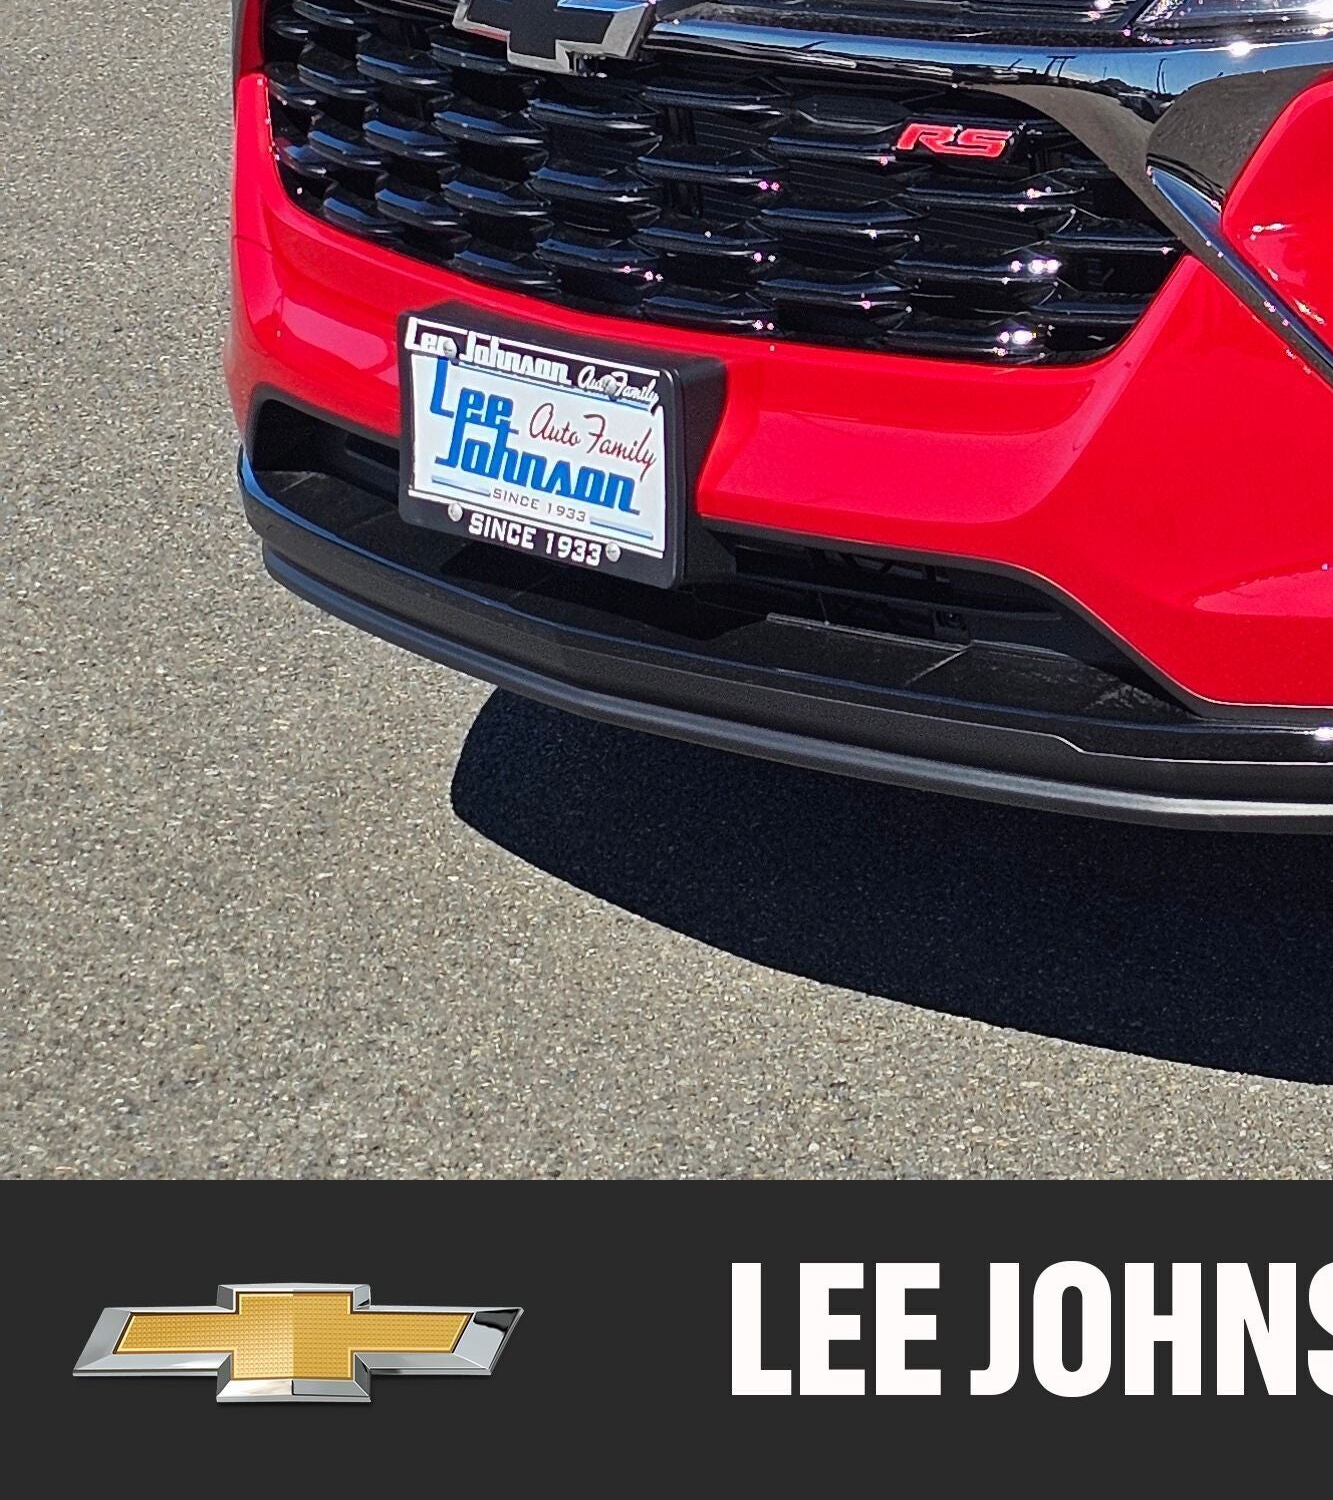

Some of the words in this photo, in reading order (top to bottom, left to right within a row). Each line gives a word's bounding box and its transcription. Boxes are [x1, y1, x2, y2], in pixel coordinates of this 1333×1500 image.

[897, 123, 1013, 158] RS
[459, 330, 572, 386] Johnson
[577, 366, 612, 394] Aut
[611, 372, 661, 407] Family
[430, 357, 519, 435] Lee
[529, 403, 582, 447] Auto
[583, 413, 657, 481] Family
[434, 418, 641, 516] Johnson
[493, 488, 540, 510] SINCE
[547, 498, 587, 522] 1933
[468, 513, 538, 550] SINCE
[544, 532, 602, 567] 1933
